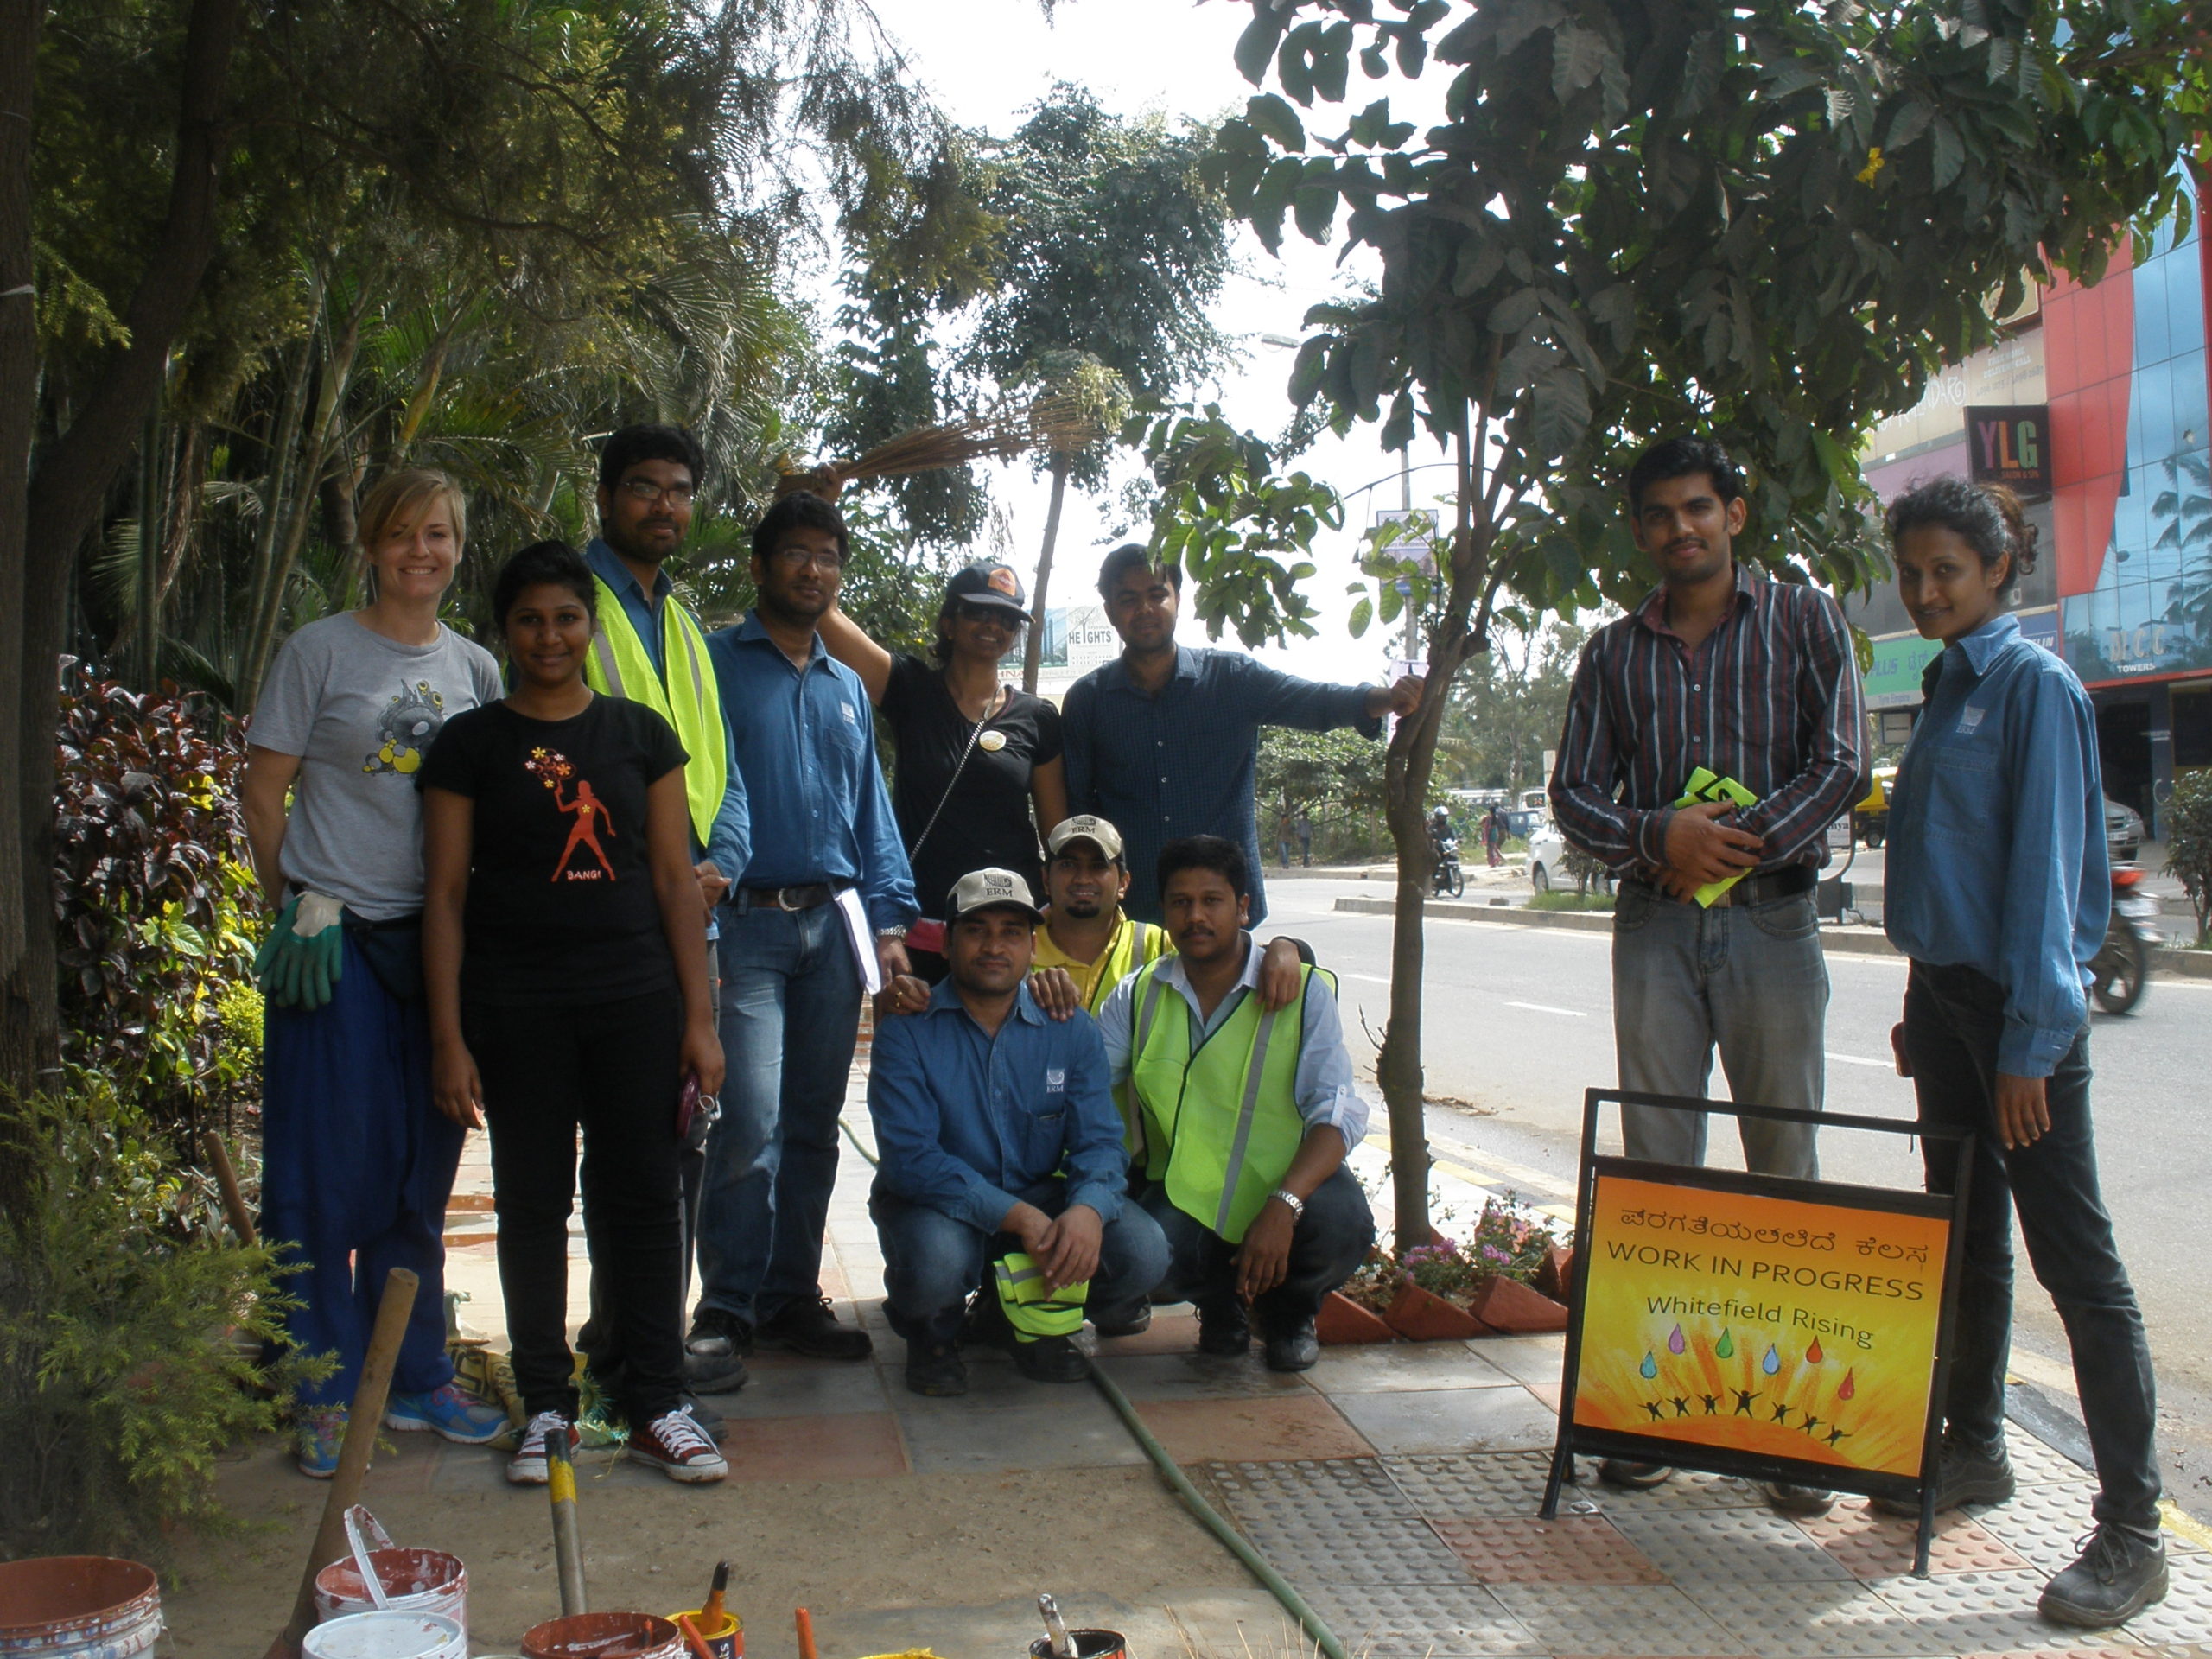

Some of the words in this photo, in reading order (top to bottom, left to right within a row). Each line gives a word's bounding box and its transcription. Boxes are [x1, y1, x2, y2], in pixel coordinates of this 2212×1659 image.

[1977, 420, 2038, 469] YLG
[1069, 621, 1112, 645] HEIGHTS
[2117, 663, 2156, 673] TOWERS
[987, 887, 1013, 898] ERM
[1047, 1084, 1064, 1093] ERM
[1607, 1240, 1700, 1272] WORK
[1712, 1255, 1741, 1278] IN
[1752, 1262, 1923, 1301] PROGRESS
[1647, 1296, 1782, 1324] Whitefield
[1793, 1308, 1874, 1350] Rising
